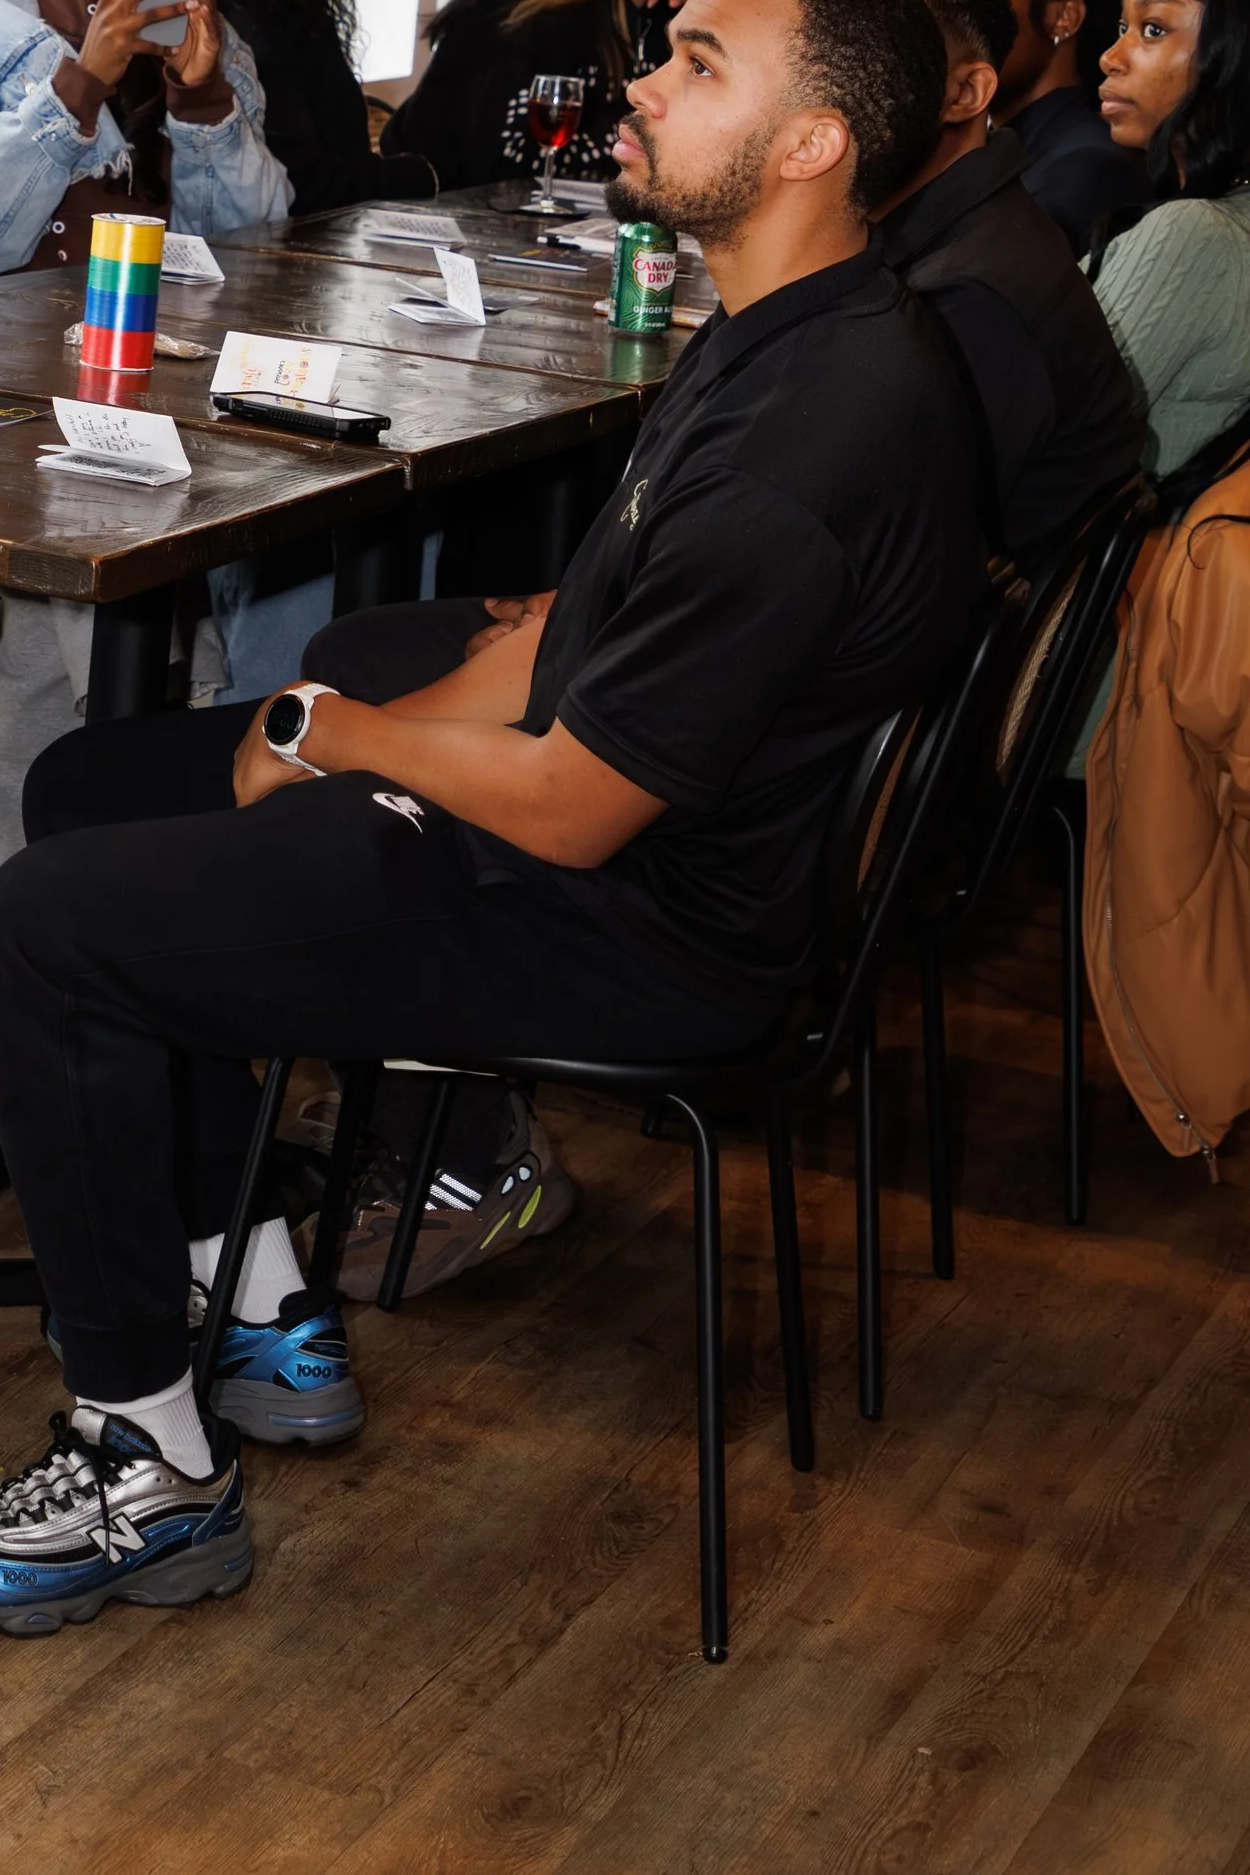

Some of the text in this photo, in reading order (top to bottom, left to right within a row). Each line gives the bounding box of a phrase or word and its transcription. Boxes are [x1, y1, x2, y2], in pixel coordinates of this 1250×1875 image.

[648, 272, 669, 283] DRY
[632, 305, 663, 314] GINGER
[295, 1363, 333, 1380] 1000
[87, 1513, 147, 1566] N
[1, 1568, 39, 1589] 1000
